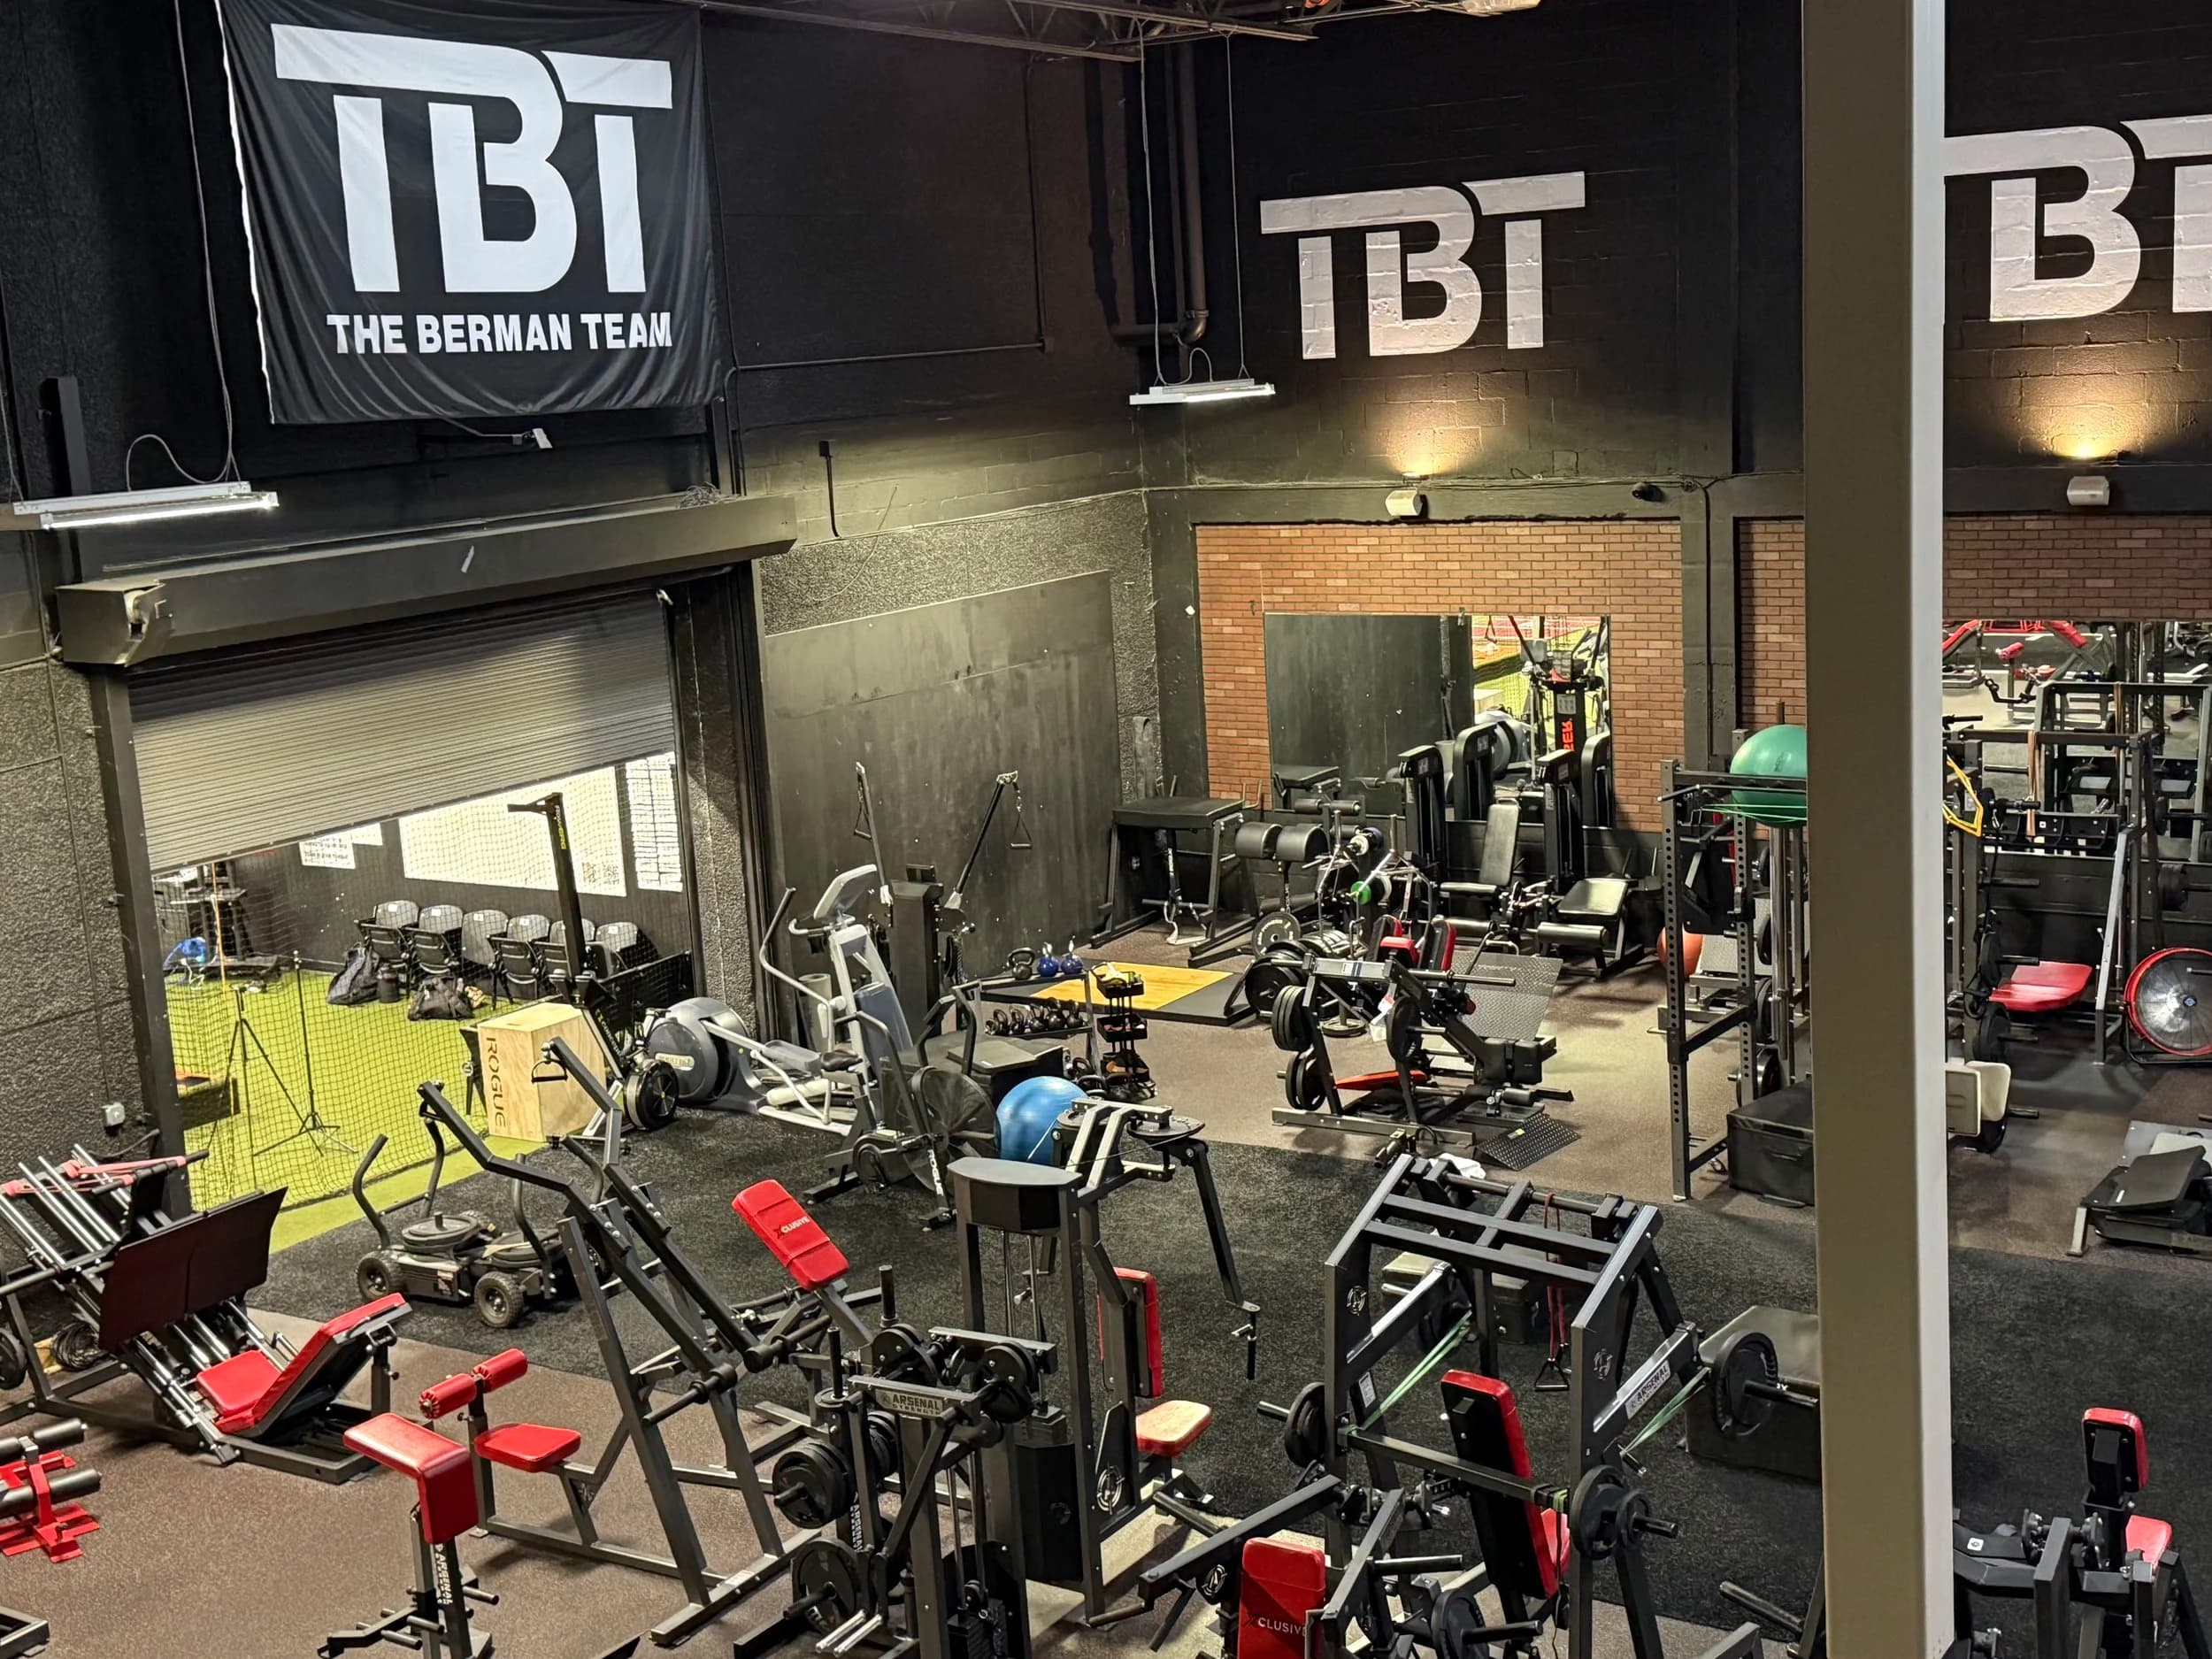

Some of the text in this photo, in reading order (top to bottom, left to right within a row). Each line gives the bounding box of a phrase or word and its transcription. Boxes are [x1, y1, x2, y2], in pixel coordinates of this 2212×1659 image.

[271, 23, 672, 292] TBT
[1944, 114, 2212, 322] BT
[1260, 171, 1586, 359] TBT
[326, 311, 672, 354] THE BERMAN TEAM
[486, 1036, 506, 1127] ROGUE
[926, 1148, 944, 1197] ROGUE
[892, 1394, 941, 1410] ARSENAL
[1637, 1364, 1669, 1403] ARSENAL
[438, 1553, 453, 1605] ARSENAL
